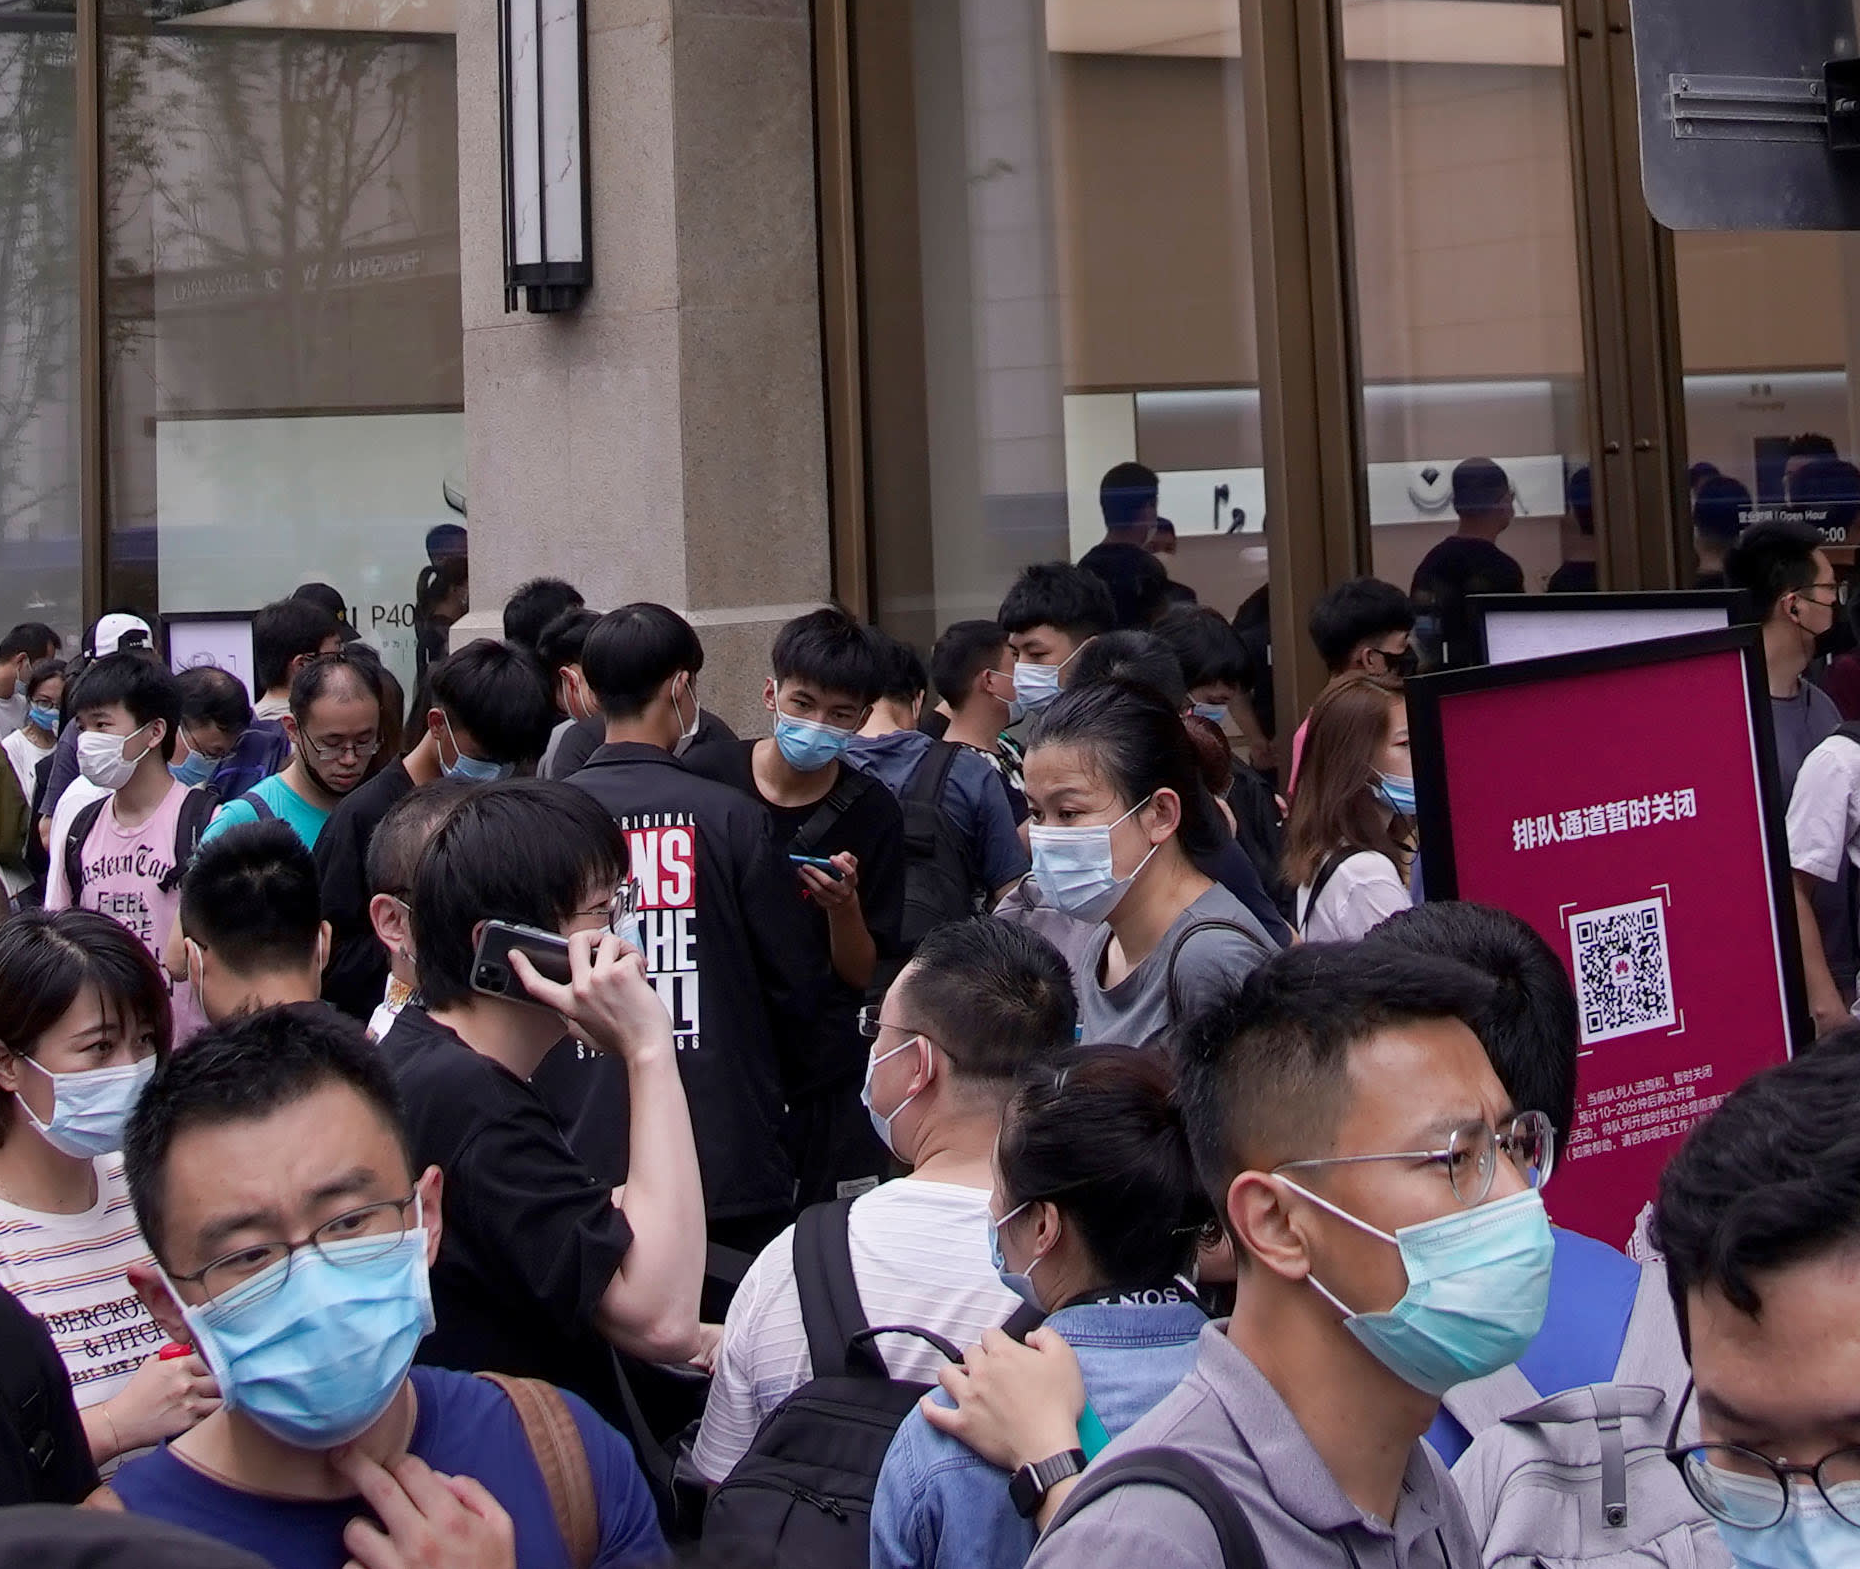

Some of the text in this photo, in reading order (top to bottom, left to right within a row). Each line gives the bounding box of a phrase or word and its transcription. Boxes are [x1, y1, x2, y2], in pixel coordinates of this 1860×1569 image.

[614, 812, 696, 831] RIGINAL
[1511, 787, 1698, 852] 排队通道暂时关闭
[82, 854, 133, 886] astern
[630, 828, 692, 908] NS
[97, 891, 149, 914] FEEL
[83, 1338, 103, 1358] &
